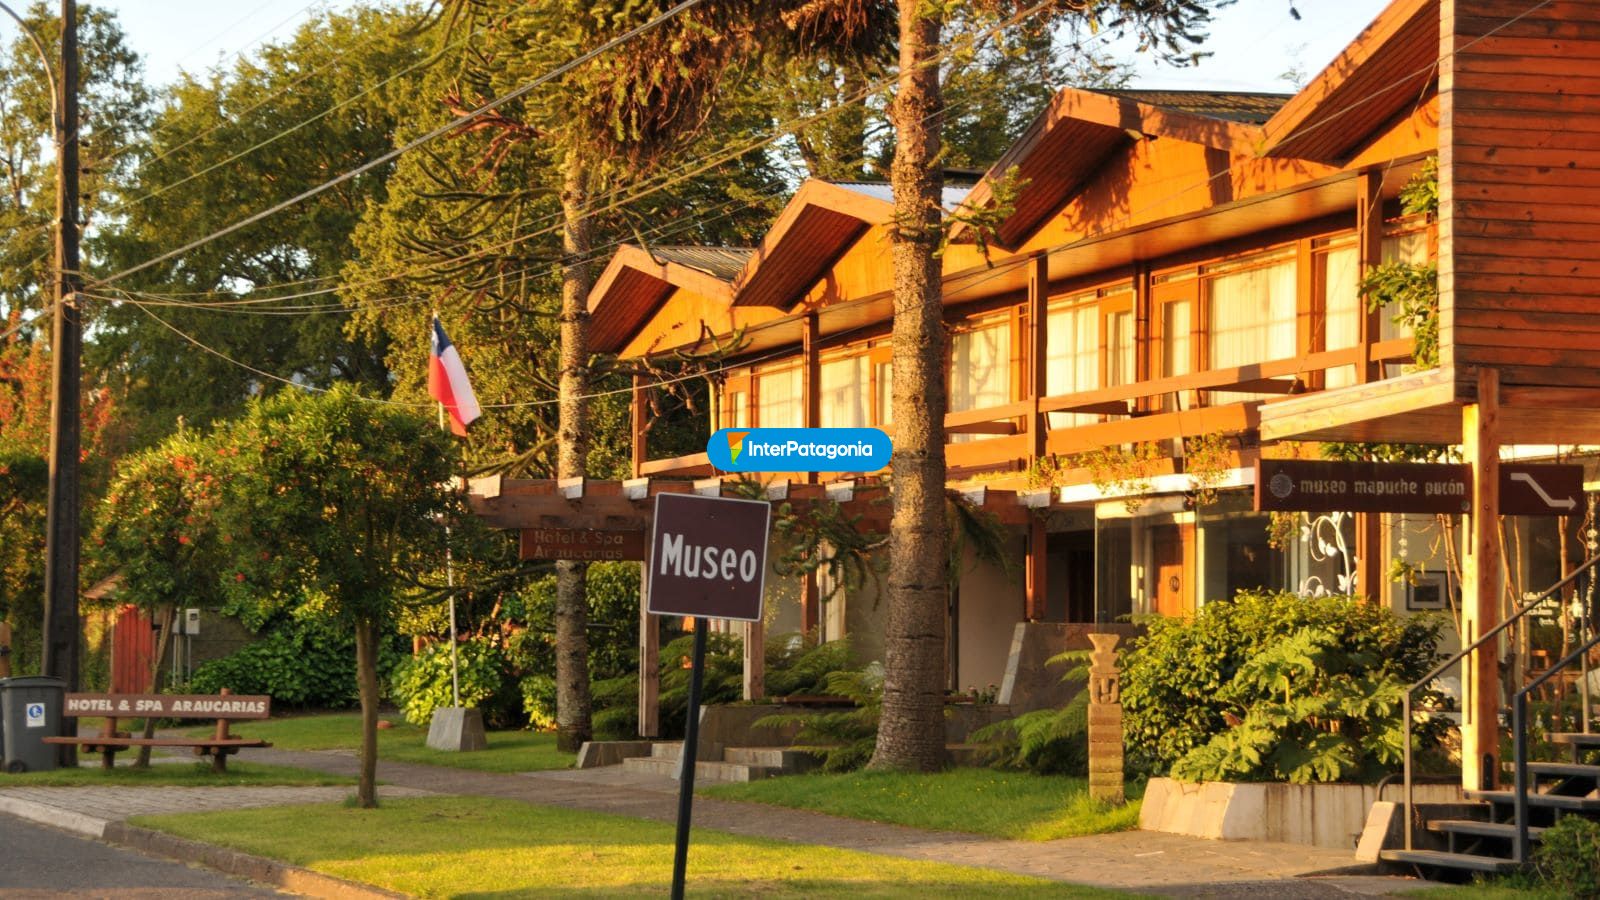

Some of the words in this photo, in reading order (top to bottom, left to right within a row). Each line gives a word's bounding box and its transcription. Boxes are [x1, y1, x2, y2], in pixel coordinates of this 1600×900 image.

[1301, 479, 1347, 494] museo
[1354, 478, 1418, 495] mapuche
[1425, 478, 1465, 496] pucón
[534, 530, 575, 545] Hotel
[579, 531, 589, 545] &
[595, 531, 624, 546] Spa
[660, 533, 757, 583] Museo
[68, 699, 114, 711] HOTEL
[118, 699, 130, 711] &
[135, 700, 163, 711] SPA
[171, 700, 266, 713] ARAUCARIAS
